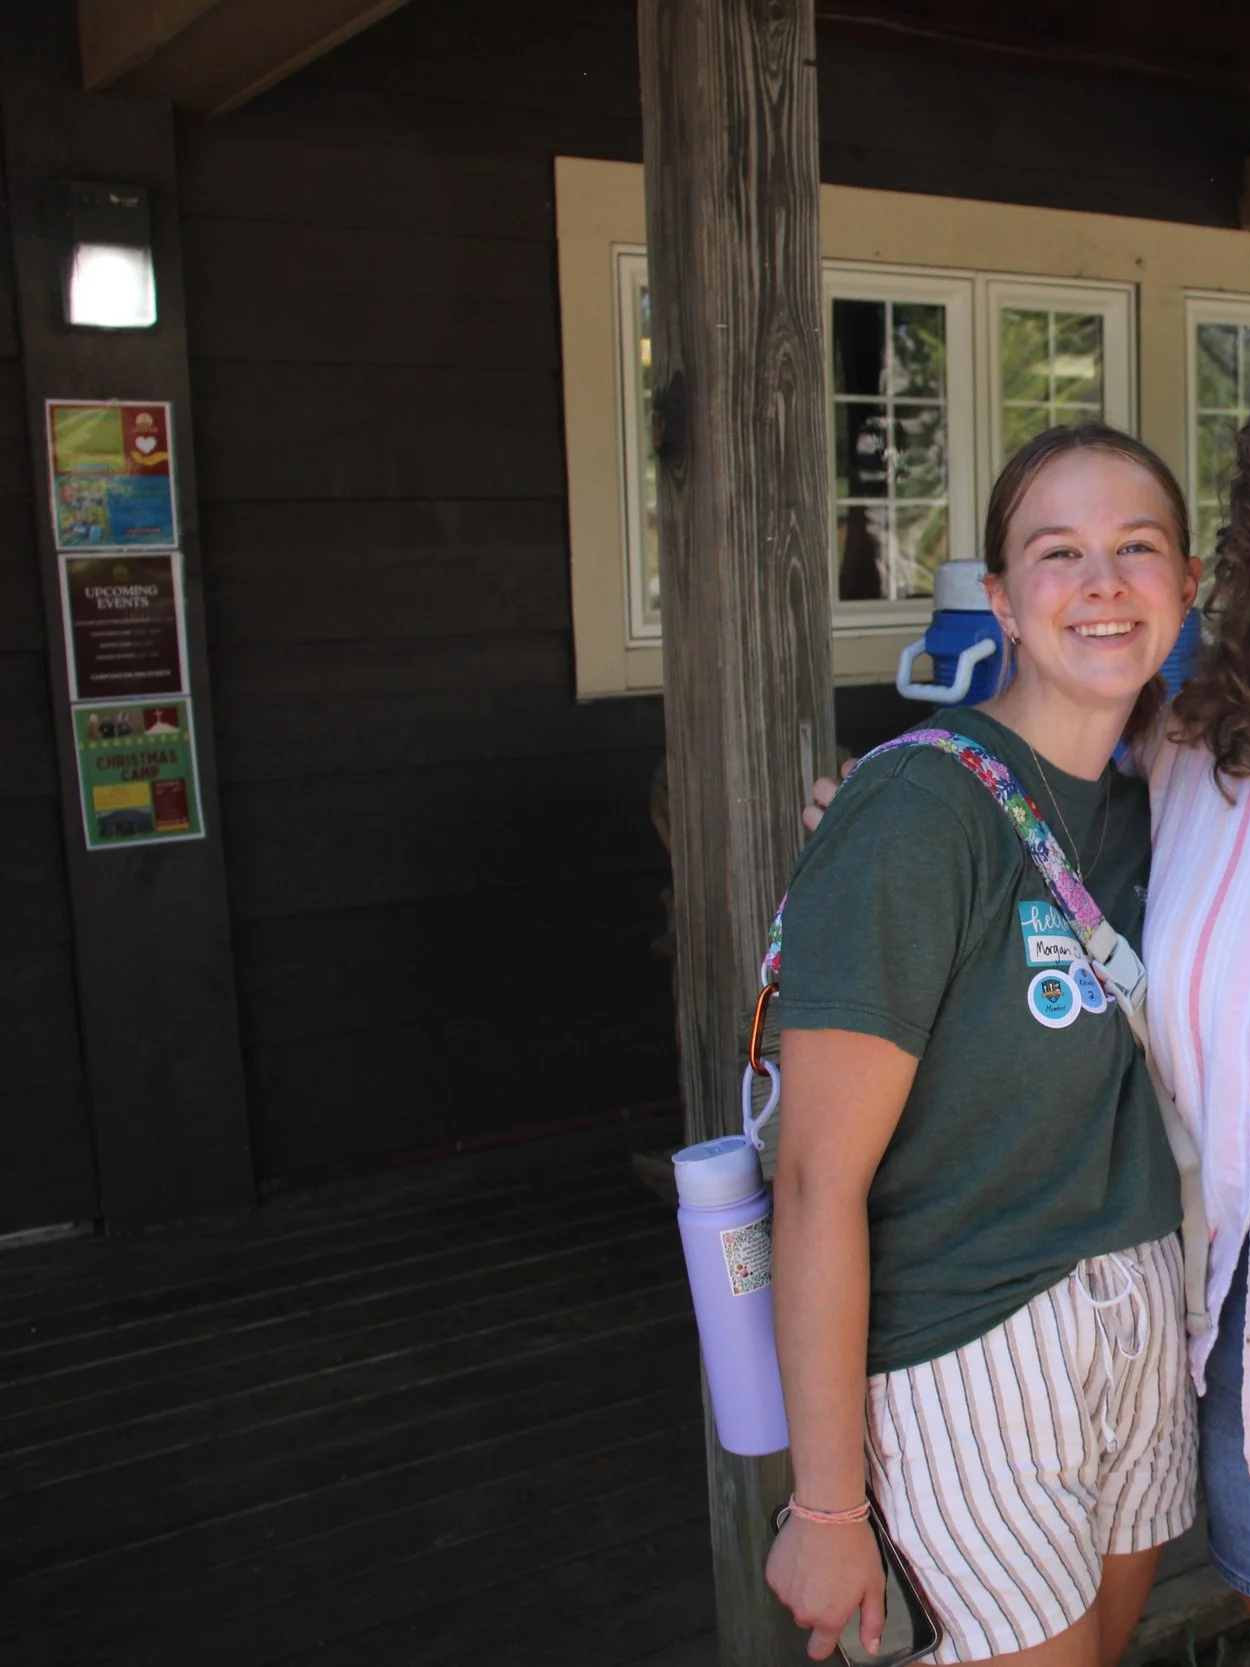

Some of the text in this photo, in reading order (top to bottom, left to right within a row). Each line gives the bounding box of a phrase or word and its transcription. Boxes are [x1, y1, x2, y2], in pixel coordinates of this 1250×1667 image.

[84, 584, 159, 600] UPCOMING
[96, 596, 150, 610] EVENTS
[96, 750, 178, 770] CHRISTMAS
[120, 765, 160, 781] CAMP
[1036, 940, 1072, 964] Morgan
